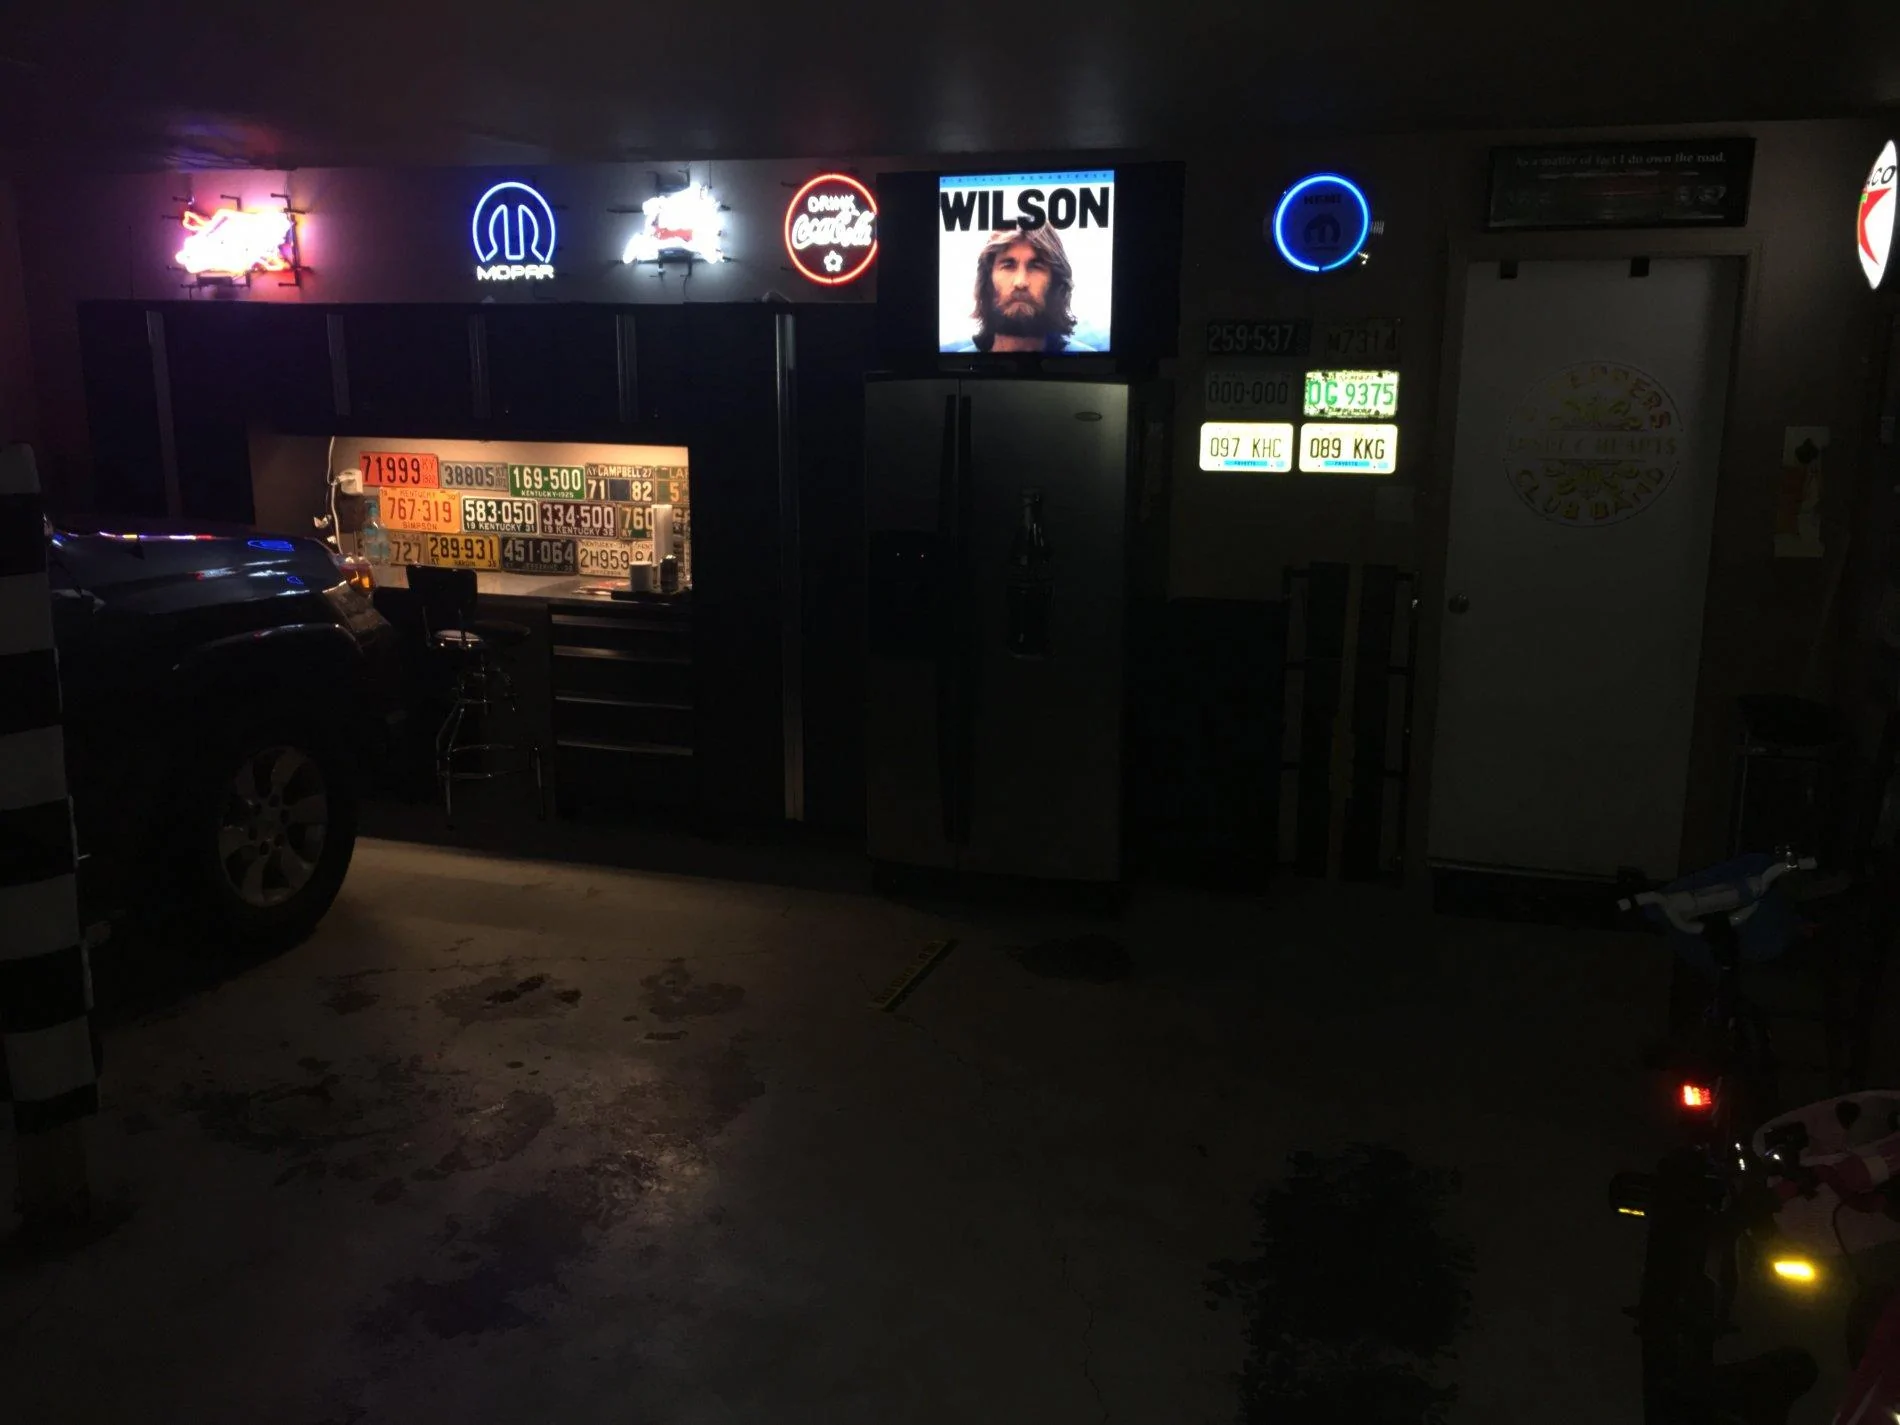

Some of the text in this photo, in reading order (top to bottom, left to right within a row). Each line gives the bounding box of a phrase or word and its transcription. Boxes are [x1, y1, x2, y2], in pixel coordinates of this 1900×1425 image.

[1628, 153, 1643, 164] do
[1645, 155, 1672, 165] own
[1675, 152, 1694, 163] the
[941, 187, 1109, 231] WILSON
[477, 265, 554, 281] MOPAR
[1345, 383, 1394, 406] 9375
[1210, 437, 1282, 458] 097 KHC
[1310, 438, 1385, 460] 089 KKG
[362, 456, 421, 485] 71999
[445, 465, 496, 487] 38805
[513, 467, 581, 491] 169-500
[598, 464, 641, 478] CAMPBELL
[587, 479, 605, 500] 71
[632, 481, 652, 501] 82
[478, 523, 522, 533] KENTUCKY
[556, 526, 600, 536] KENTUCKY
[580, 548, 630, 570] 2H959
